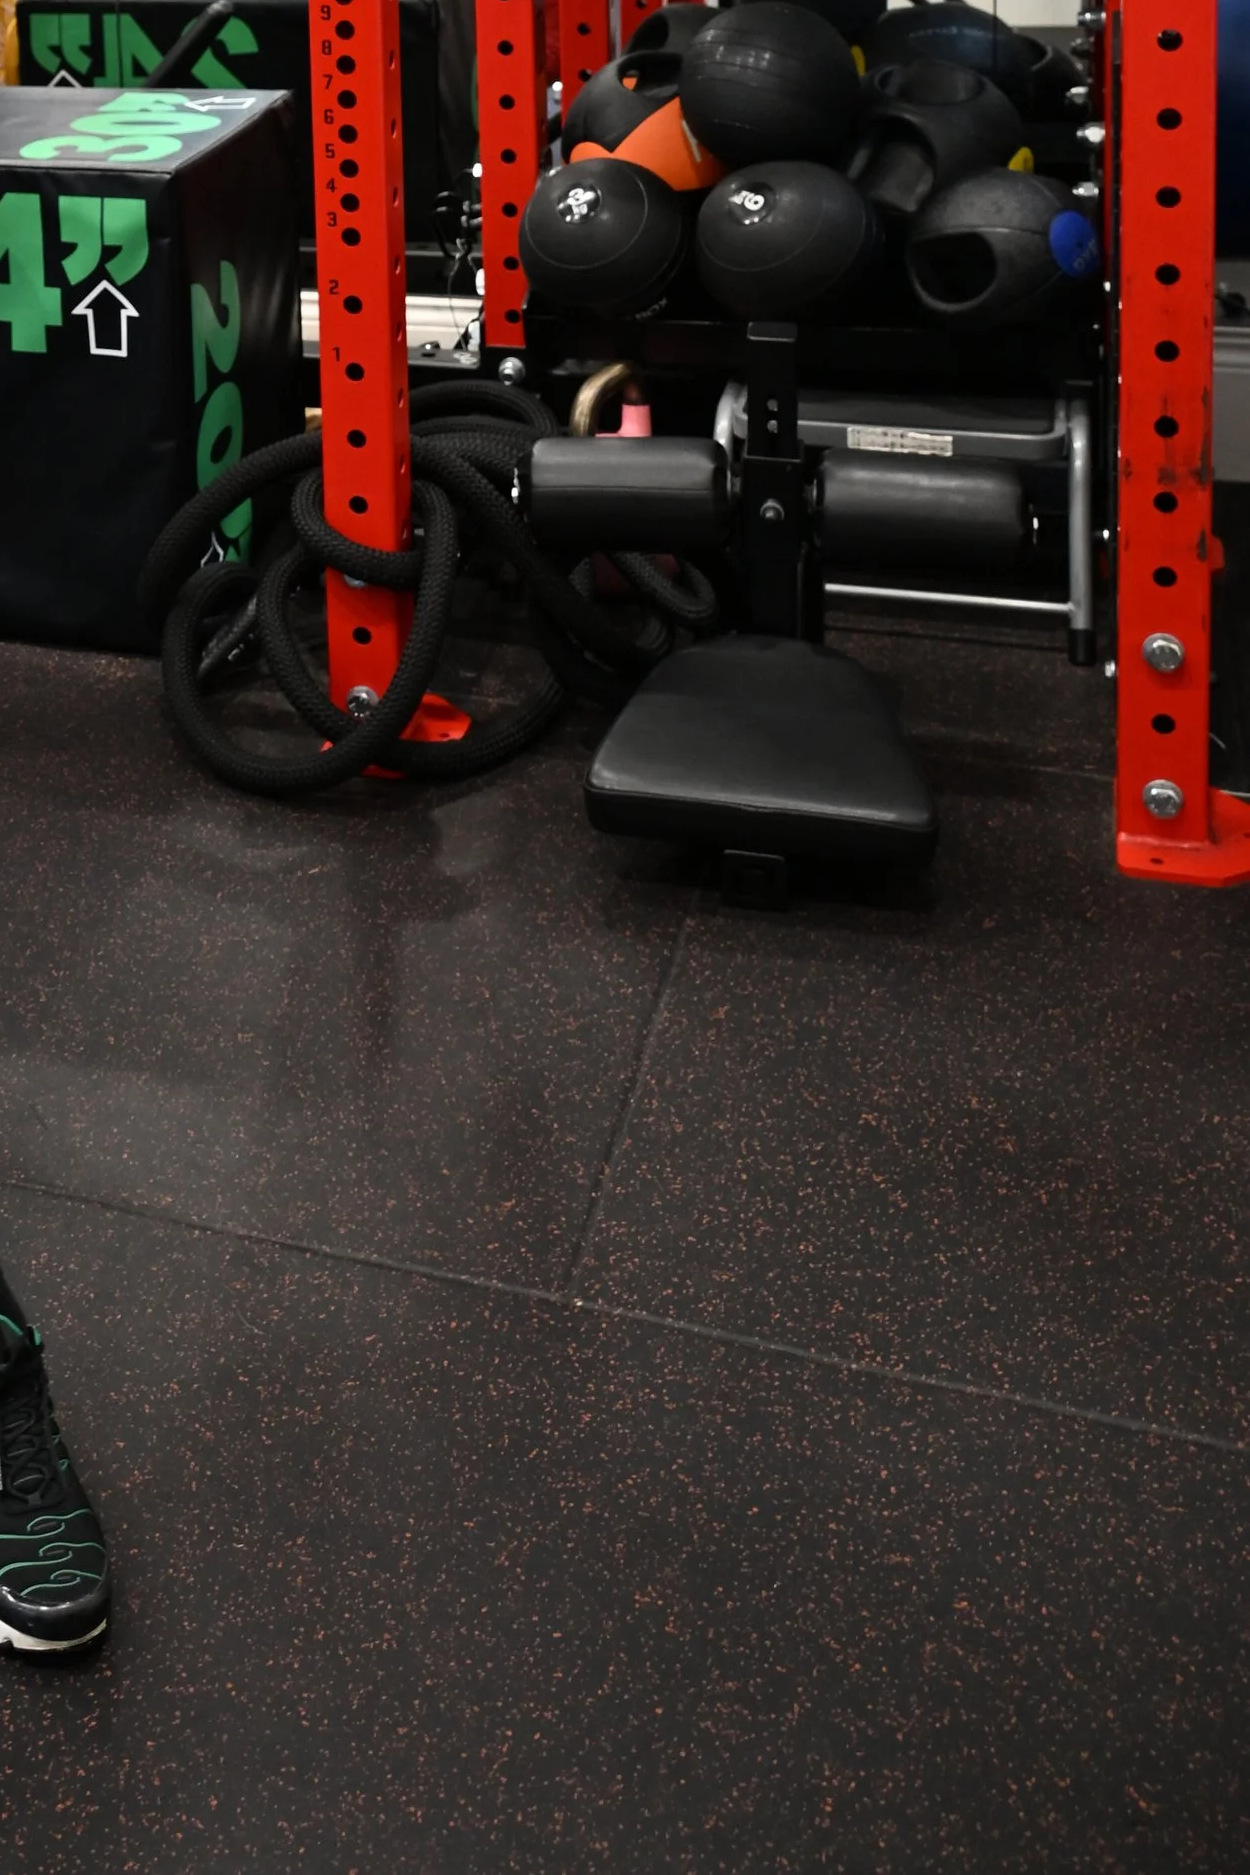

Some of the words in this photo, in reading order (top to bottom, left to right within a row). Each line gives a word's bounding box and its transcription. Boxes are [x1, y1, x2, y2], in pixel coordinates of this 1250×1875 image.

[320, 4, 332, 21] 9
[321, 39, 333, 56] 8
[323, 74, 333, 90] 7
[323, 108, 335, 125] 6
[325, 142, 336, 159] 5
[326, 177, 336, 193] 4
[327, 211, 338, 228] 3
[329, 279, 339, 295] 2
[333, 346, 341, 362] 1
